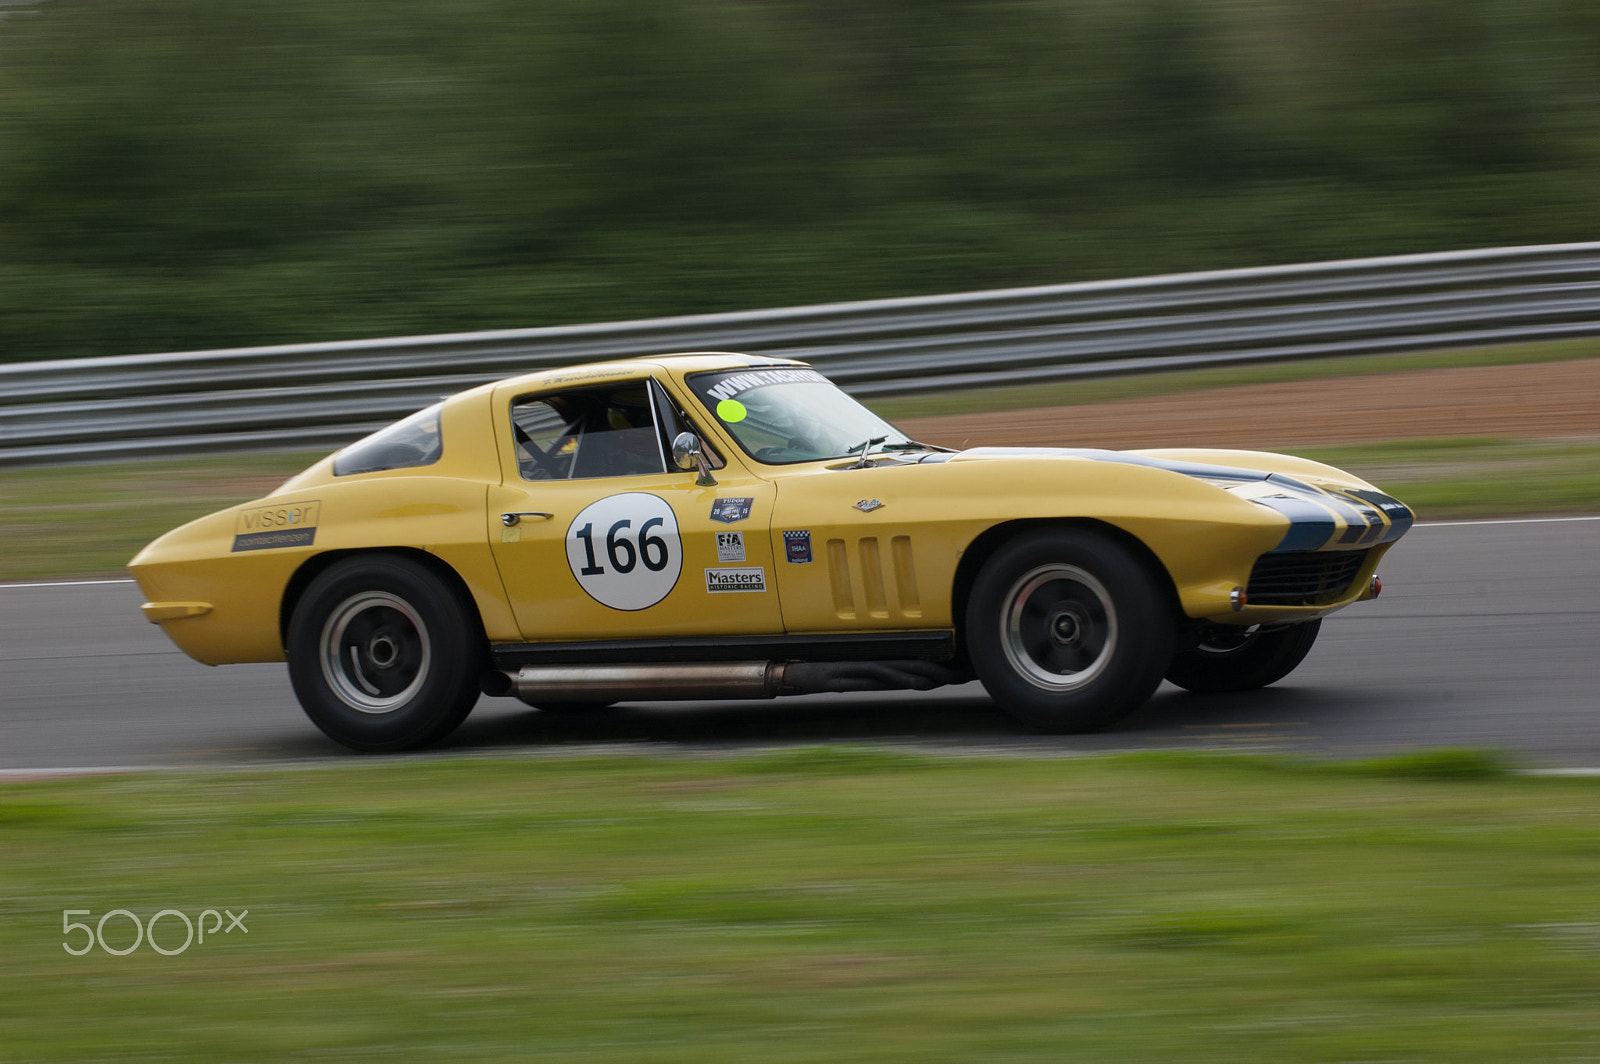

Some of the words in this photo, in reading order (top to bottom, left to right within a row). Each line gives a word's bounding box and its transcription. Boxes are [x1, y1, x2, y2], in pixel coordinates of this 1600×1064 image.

[243, 506, 312, 528] visser
[576, 517, 669, 576] 166
[708, 571, 762, 584] Masters
